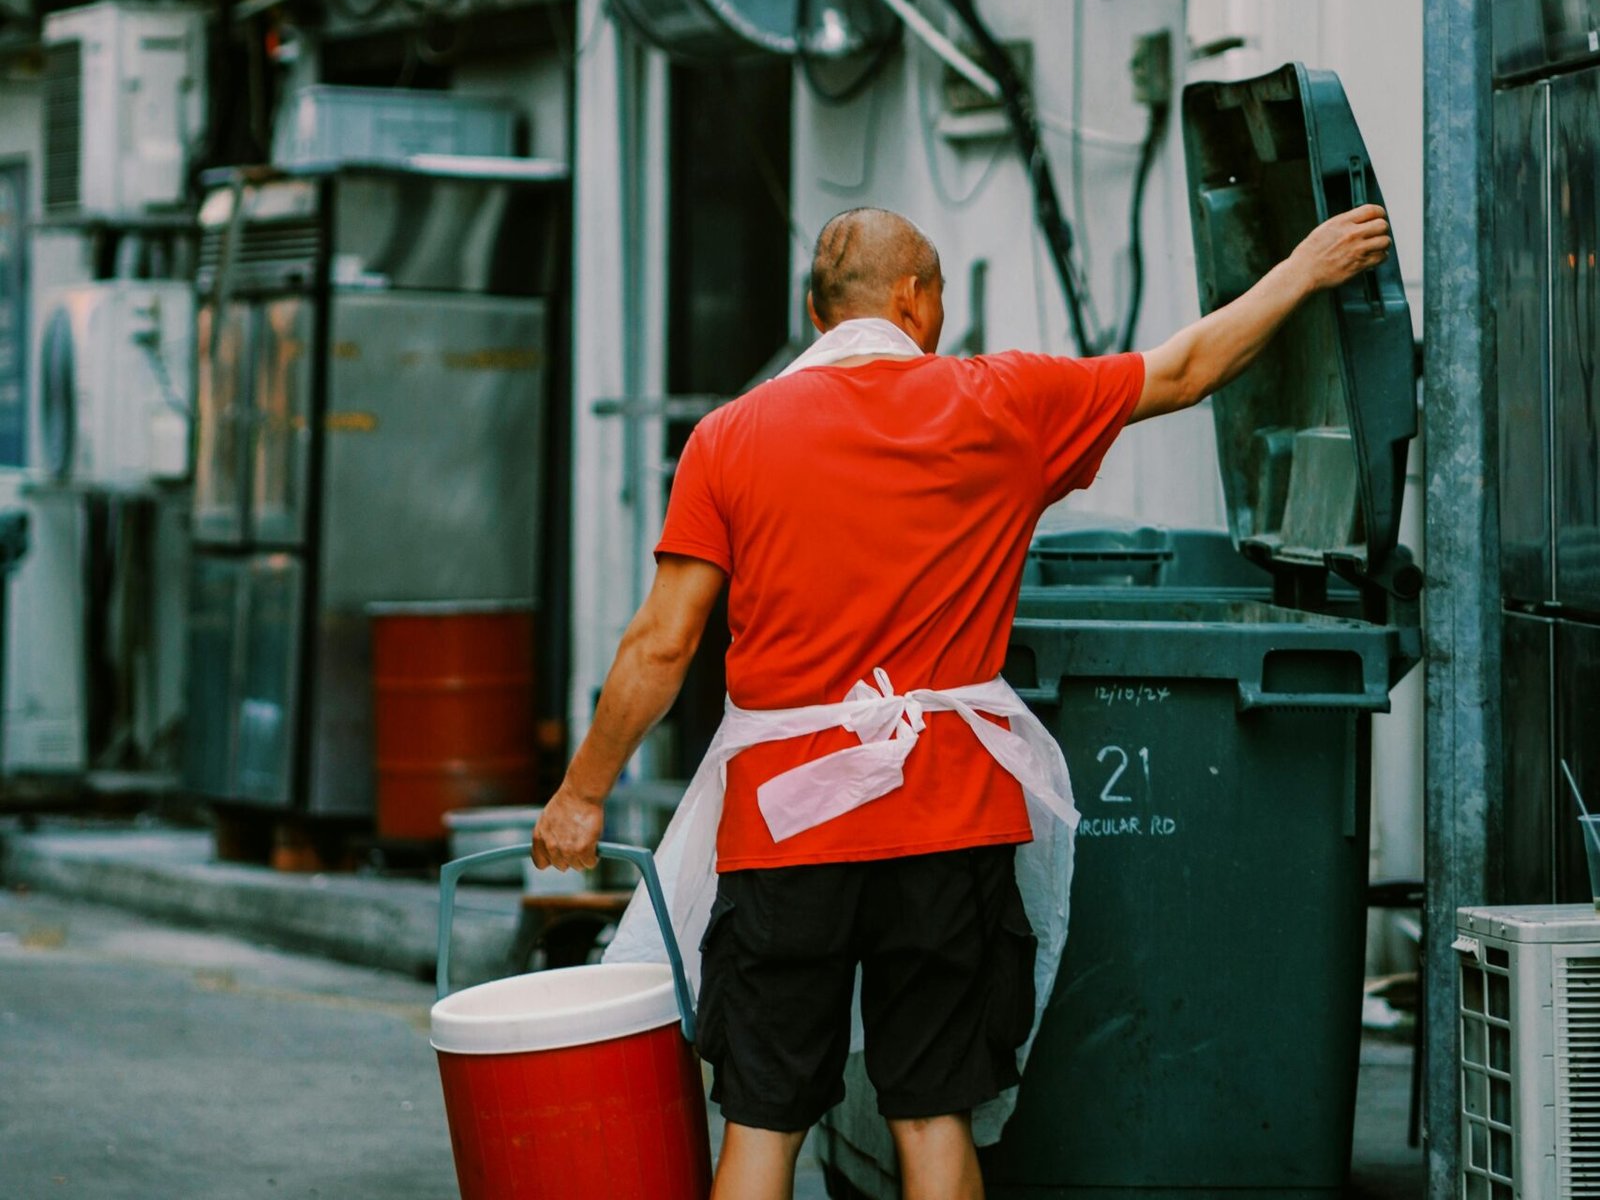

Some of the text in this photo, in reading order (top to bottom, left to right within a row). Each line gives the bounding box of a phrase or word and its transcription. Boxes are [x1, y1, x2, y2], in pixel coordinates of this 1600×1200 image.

[1096, 745, 1149, 802] 21
[1075, 814, 1176, 836] IRCULAR RD
